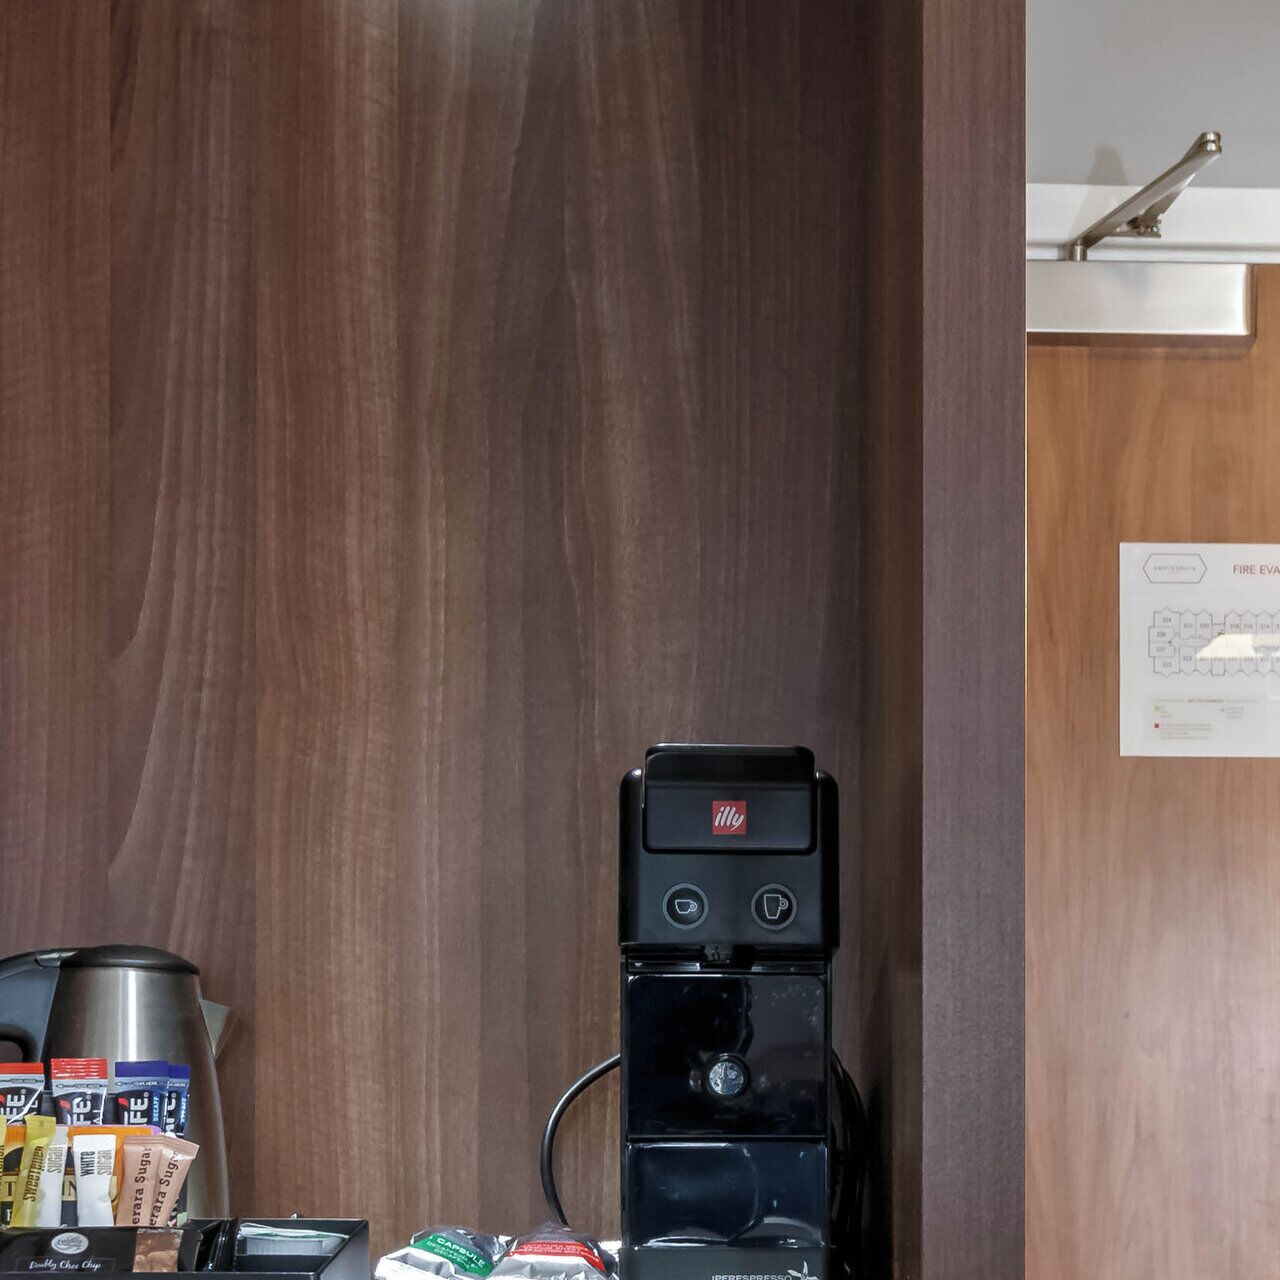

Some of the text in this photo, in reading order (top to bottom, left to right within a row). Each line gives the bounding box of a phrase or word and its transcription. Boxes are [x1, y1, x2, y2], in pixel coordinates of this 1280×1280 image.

[1232, 564, 1256, 575] FIRE
[714, 805, 745, 832] illy
[132, 1187, 145, 1225] erara
[81, 1259, 102, 1272] Chip
